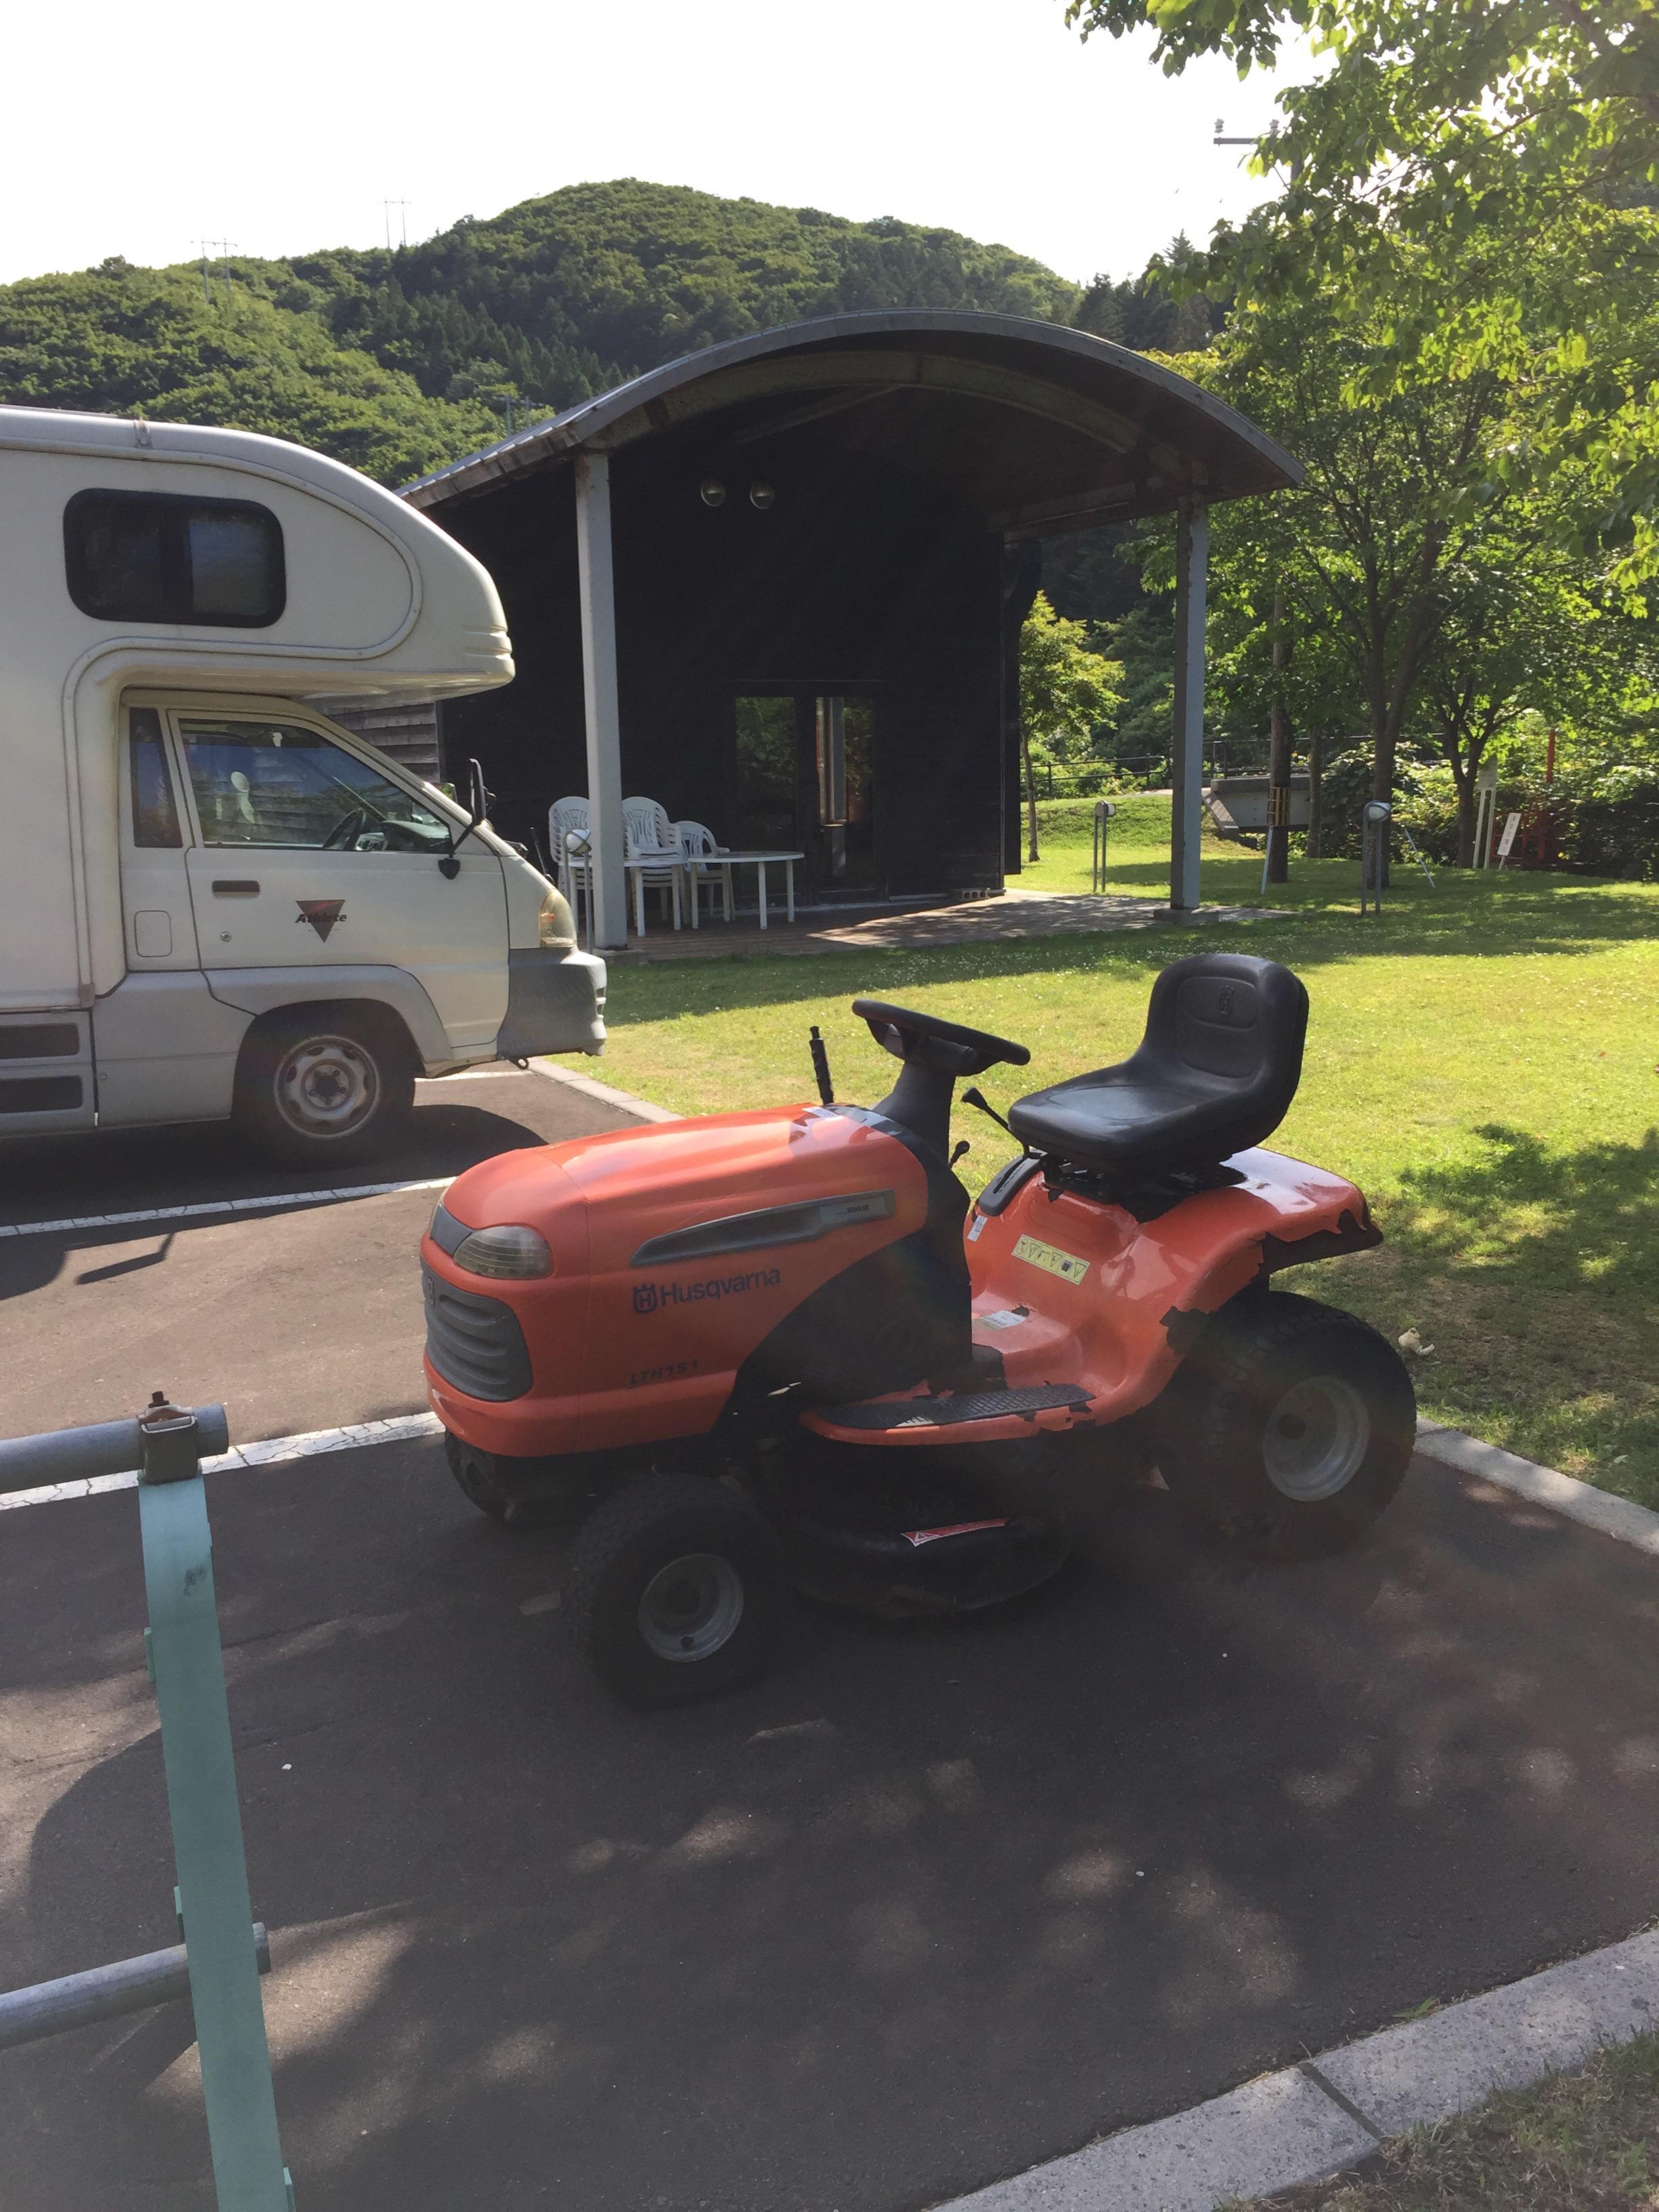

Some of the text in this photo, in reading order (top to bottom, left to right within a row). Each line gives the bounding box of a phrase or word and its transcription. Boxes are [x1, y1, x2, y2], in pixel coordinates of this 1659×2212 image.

[295, 912, 347, 923] Athlete
[660, 1269, 781, 1305] Husqvarna
[630, 1359, 698, 1385] LTH151
